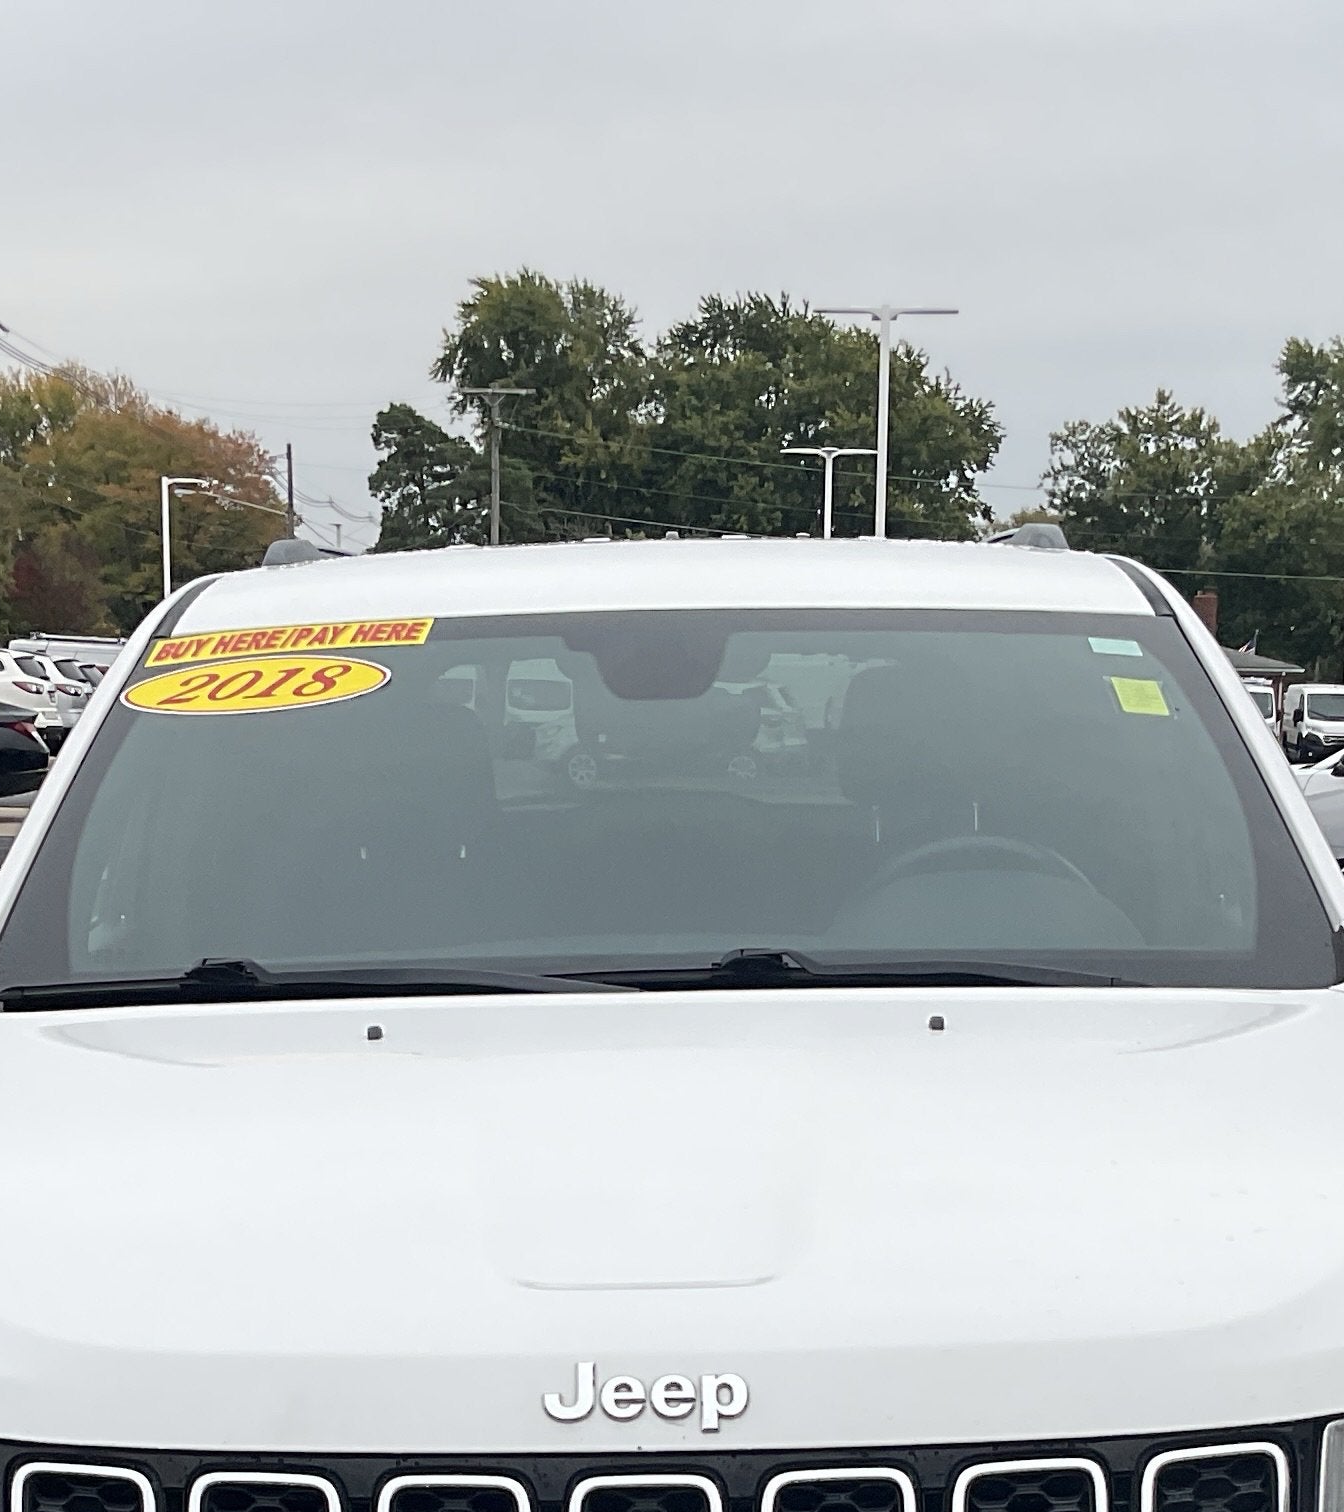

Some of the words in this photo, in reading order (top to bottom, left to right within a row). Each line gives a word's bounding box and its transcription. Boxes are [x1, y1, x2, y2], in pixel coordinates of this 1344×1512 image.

[154, 639, 207, 662] BUY
[350, 622, 425, 643] HERE
[157, 665, 352, 705] 2018
[542, 1361, 750, 1433] Jeep
